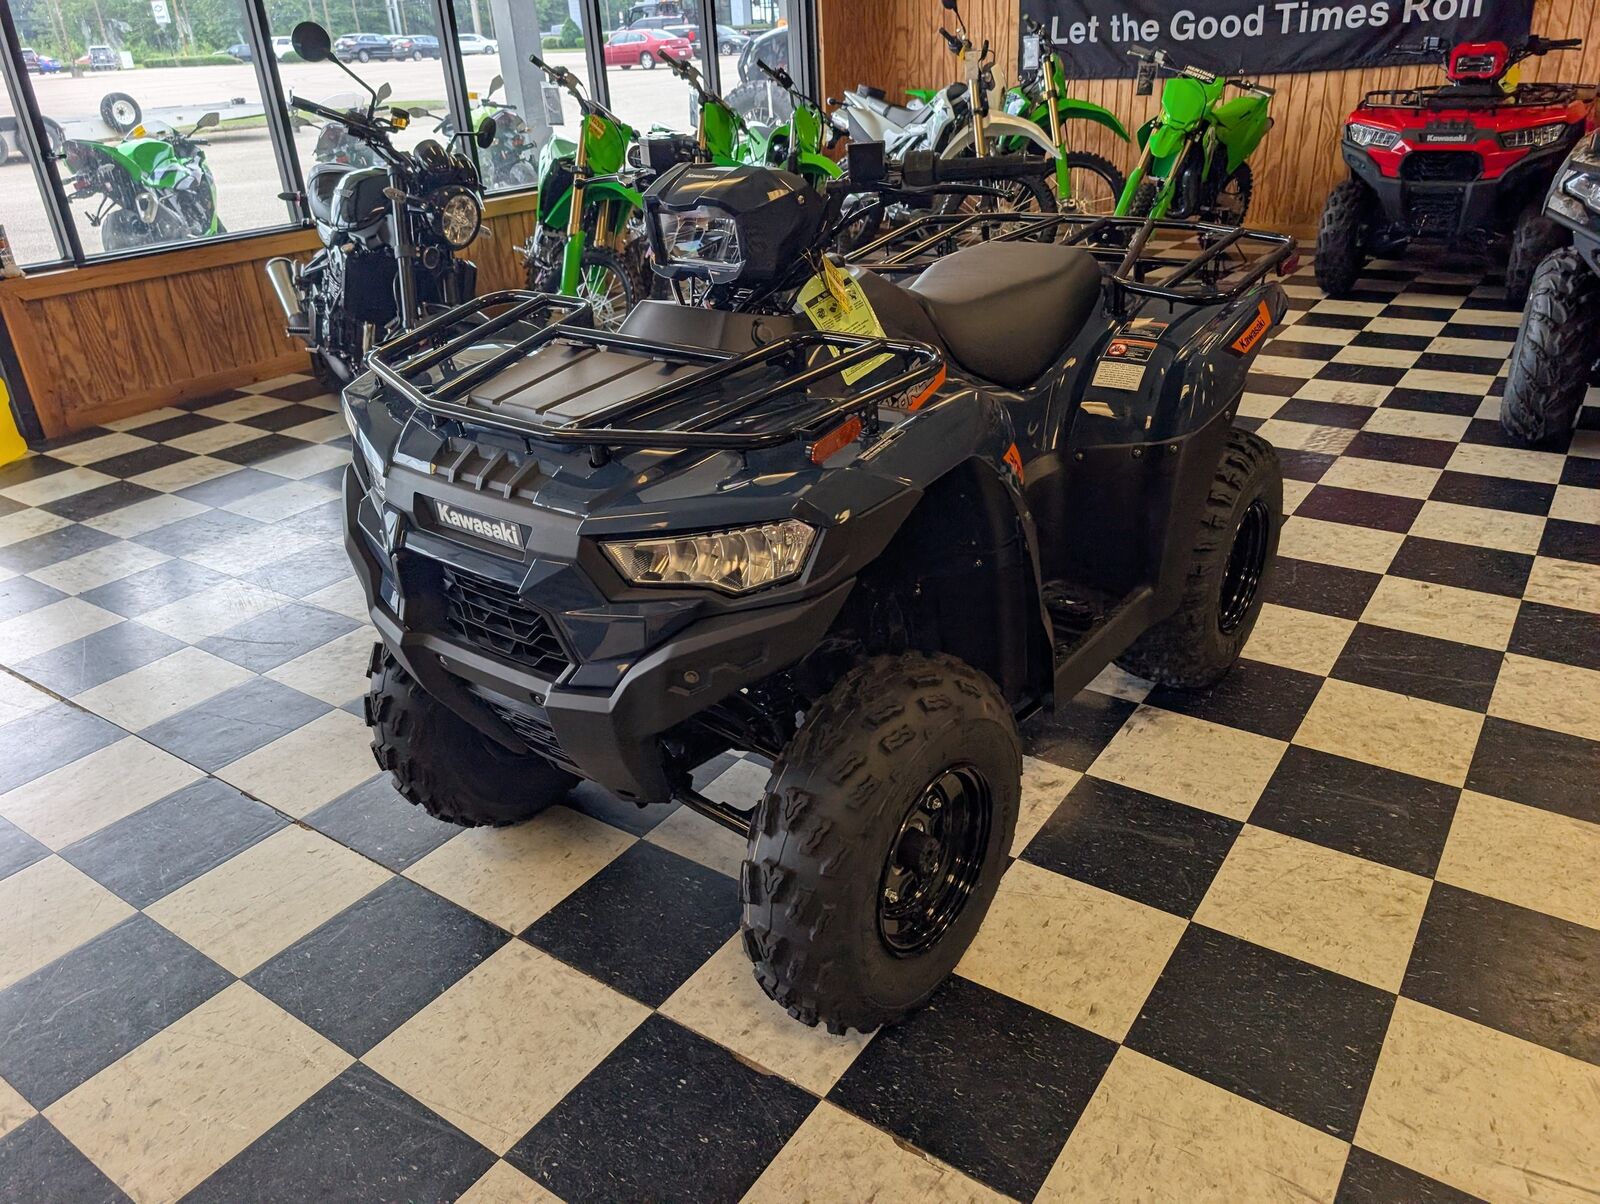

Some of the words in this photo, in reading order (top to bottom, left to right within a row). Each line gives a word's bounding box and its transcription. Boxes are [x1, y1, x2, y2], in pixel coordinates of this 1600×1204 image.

[1051, 16, 1099, 45] Let
[1110, 13, 1160, 42] the
[1170, 5, 1264, 41] Good
[1275, 2, 1389, 34] Times
[1402, 0, 1484, 23] Roll
[1427, 134, 1467, 142] Kawasaki
[436, 502, 520, 546] Kawasaki
